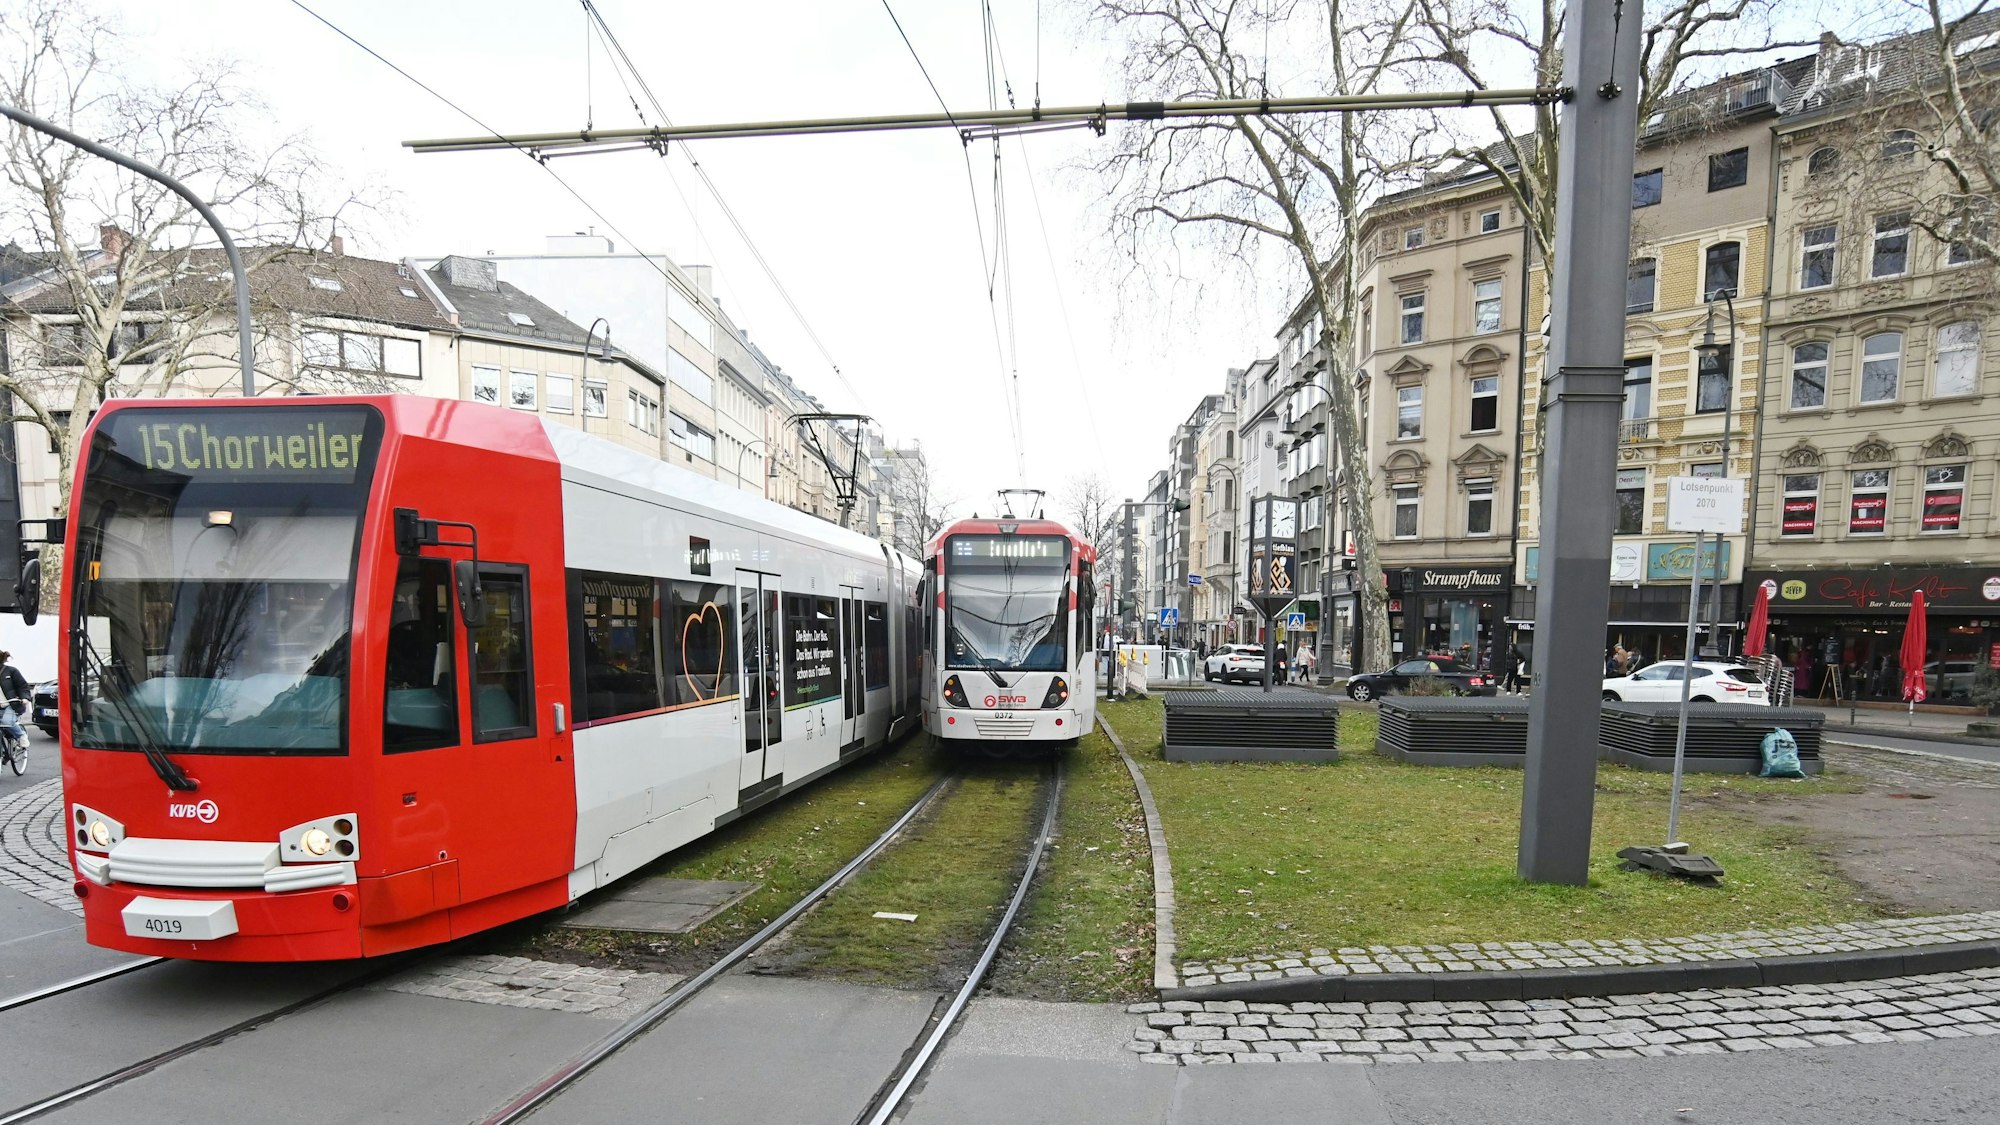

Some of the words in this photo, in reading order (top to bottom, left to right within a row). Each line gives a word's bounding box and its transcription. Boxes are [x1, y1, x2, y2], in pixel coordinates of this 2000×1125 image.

[138, 424, 175, 470] 15
[177, 422, 363, 469] Chorweiler
[1681, 482, 1733, 494] Lotsenpunkt
[1696, 498, 1716, 508] 2070
[1423, 570, 1501, 589] Strumpfhaus
[1785, 586, 1802, 595] JEVER
[1888, 575, 1969, 599] Klt
[1869, 600, 1883, 608] Bar
[1889, 600, 1930, 608] Restaunt
[998, 695, 1027, 703] SWB
[169, 804, 196, 818] KVB
[145, 919, 182, 934] 4019
